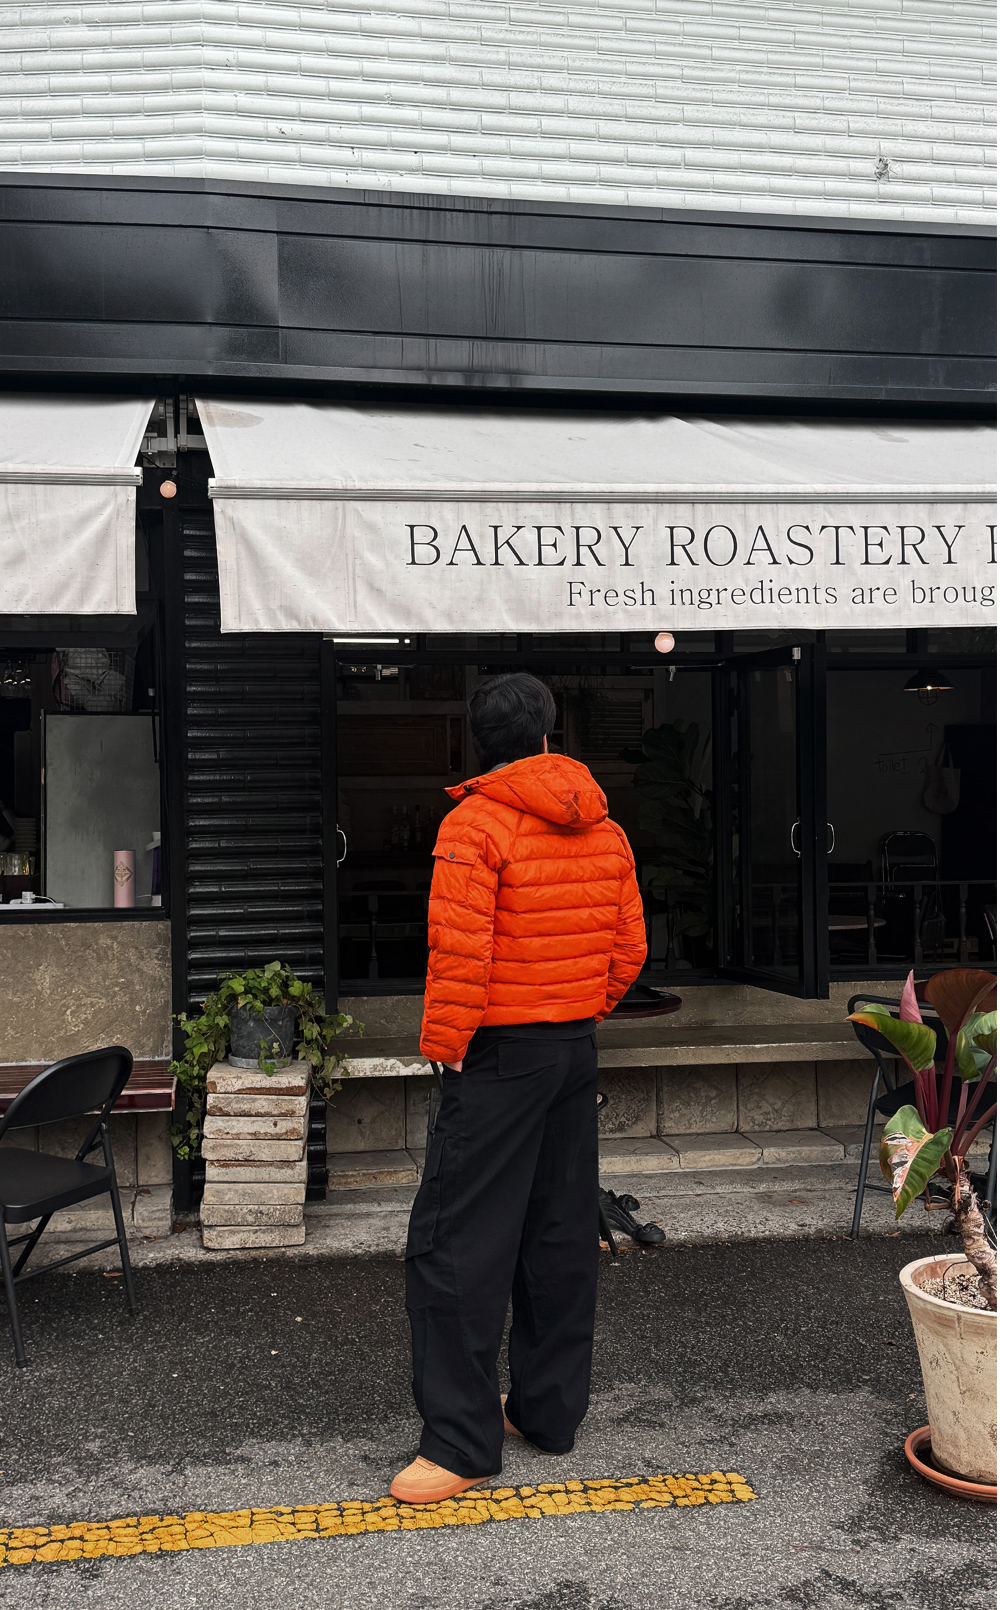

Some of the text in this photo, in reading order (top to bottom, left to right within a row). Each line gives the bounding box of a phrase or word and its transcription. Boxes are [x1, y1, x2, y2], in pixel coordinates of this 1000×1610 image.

[404, 523, 644, 567] BAKERY
[664, 523, 966, 567] ROASTERY
[566, 578, 996, 610] Fresh ingredients are broug
